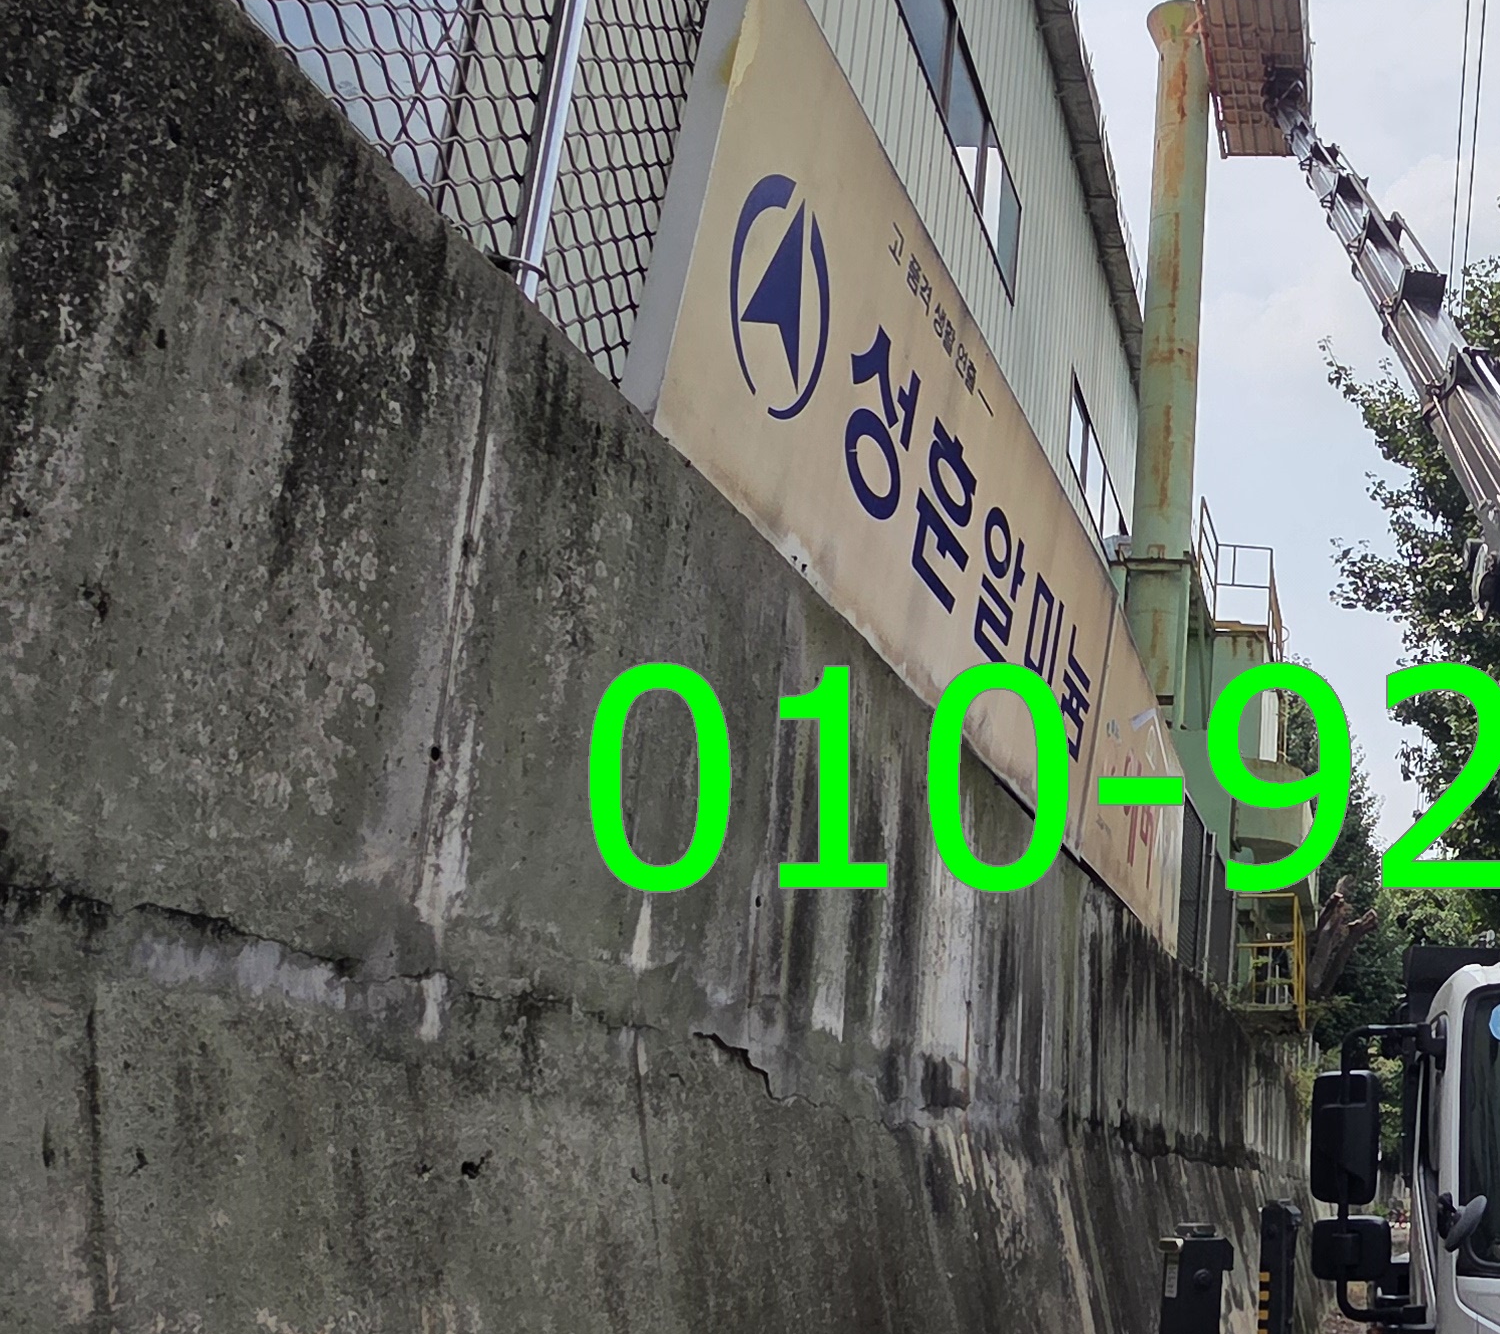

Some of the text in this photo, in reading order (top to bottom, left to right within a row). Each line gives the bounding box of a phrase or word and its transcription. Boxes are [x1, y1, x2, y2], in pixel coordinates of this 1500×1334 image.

[888, 221, 905, 266] 고
[906, 253, 933, 317] 품격
[933, 302, 956, 357] 생활
